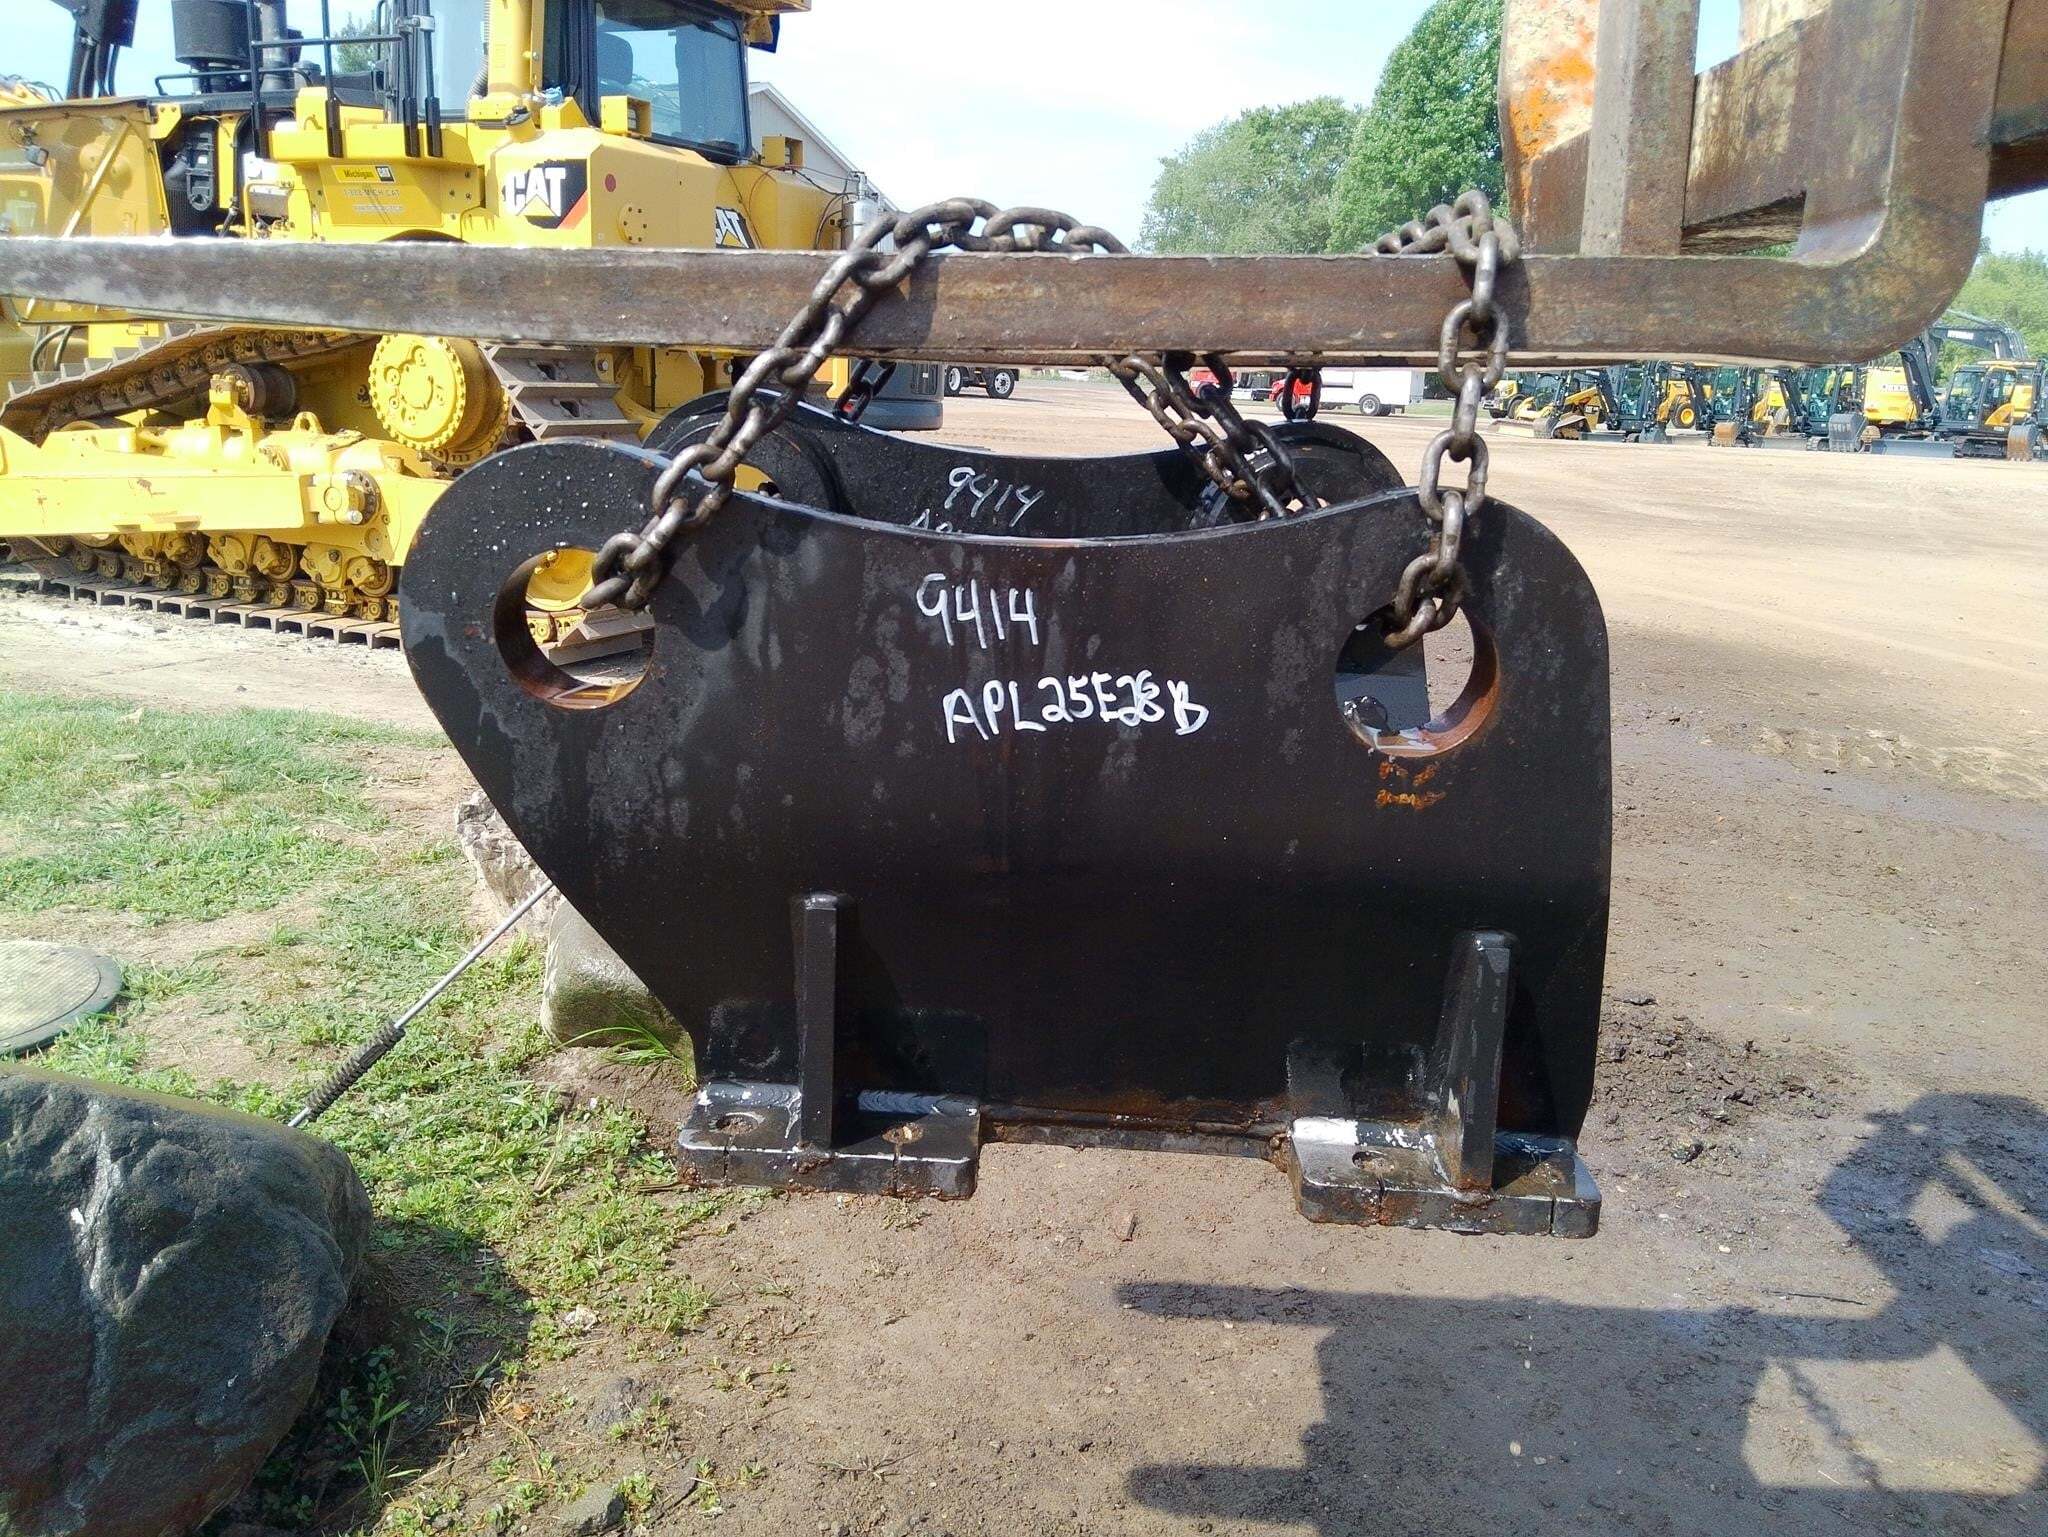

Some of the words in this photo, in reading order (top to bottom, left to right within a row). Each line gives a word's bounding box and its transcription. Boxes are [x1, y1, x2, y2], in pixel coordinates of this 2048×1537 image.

[505, 168, 567, 217] CAT
[944, 466, 1045, 527] 9414
[916, 573, 1039, 649] 9414
